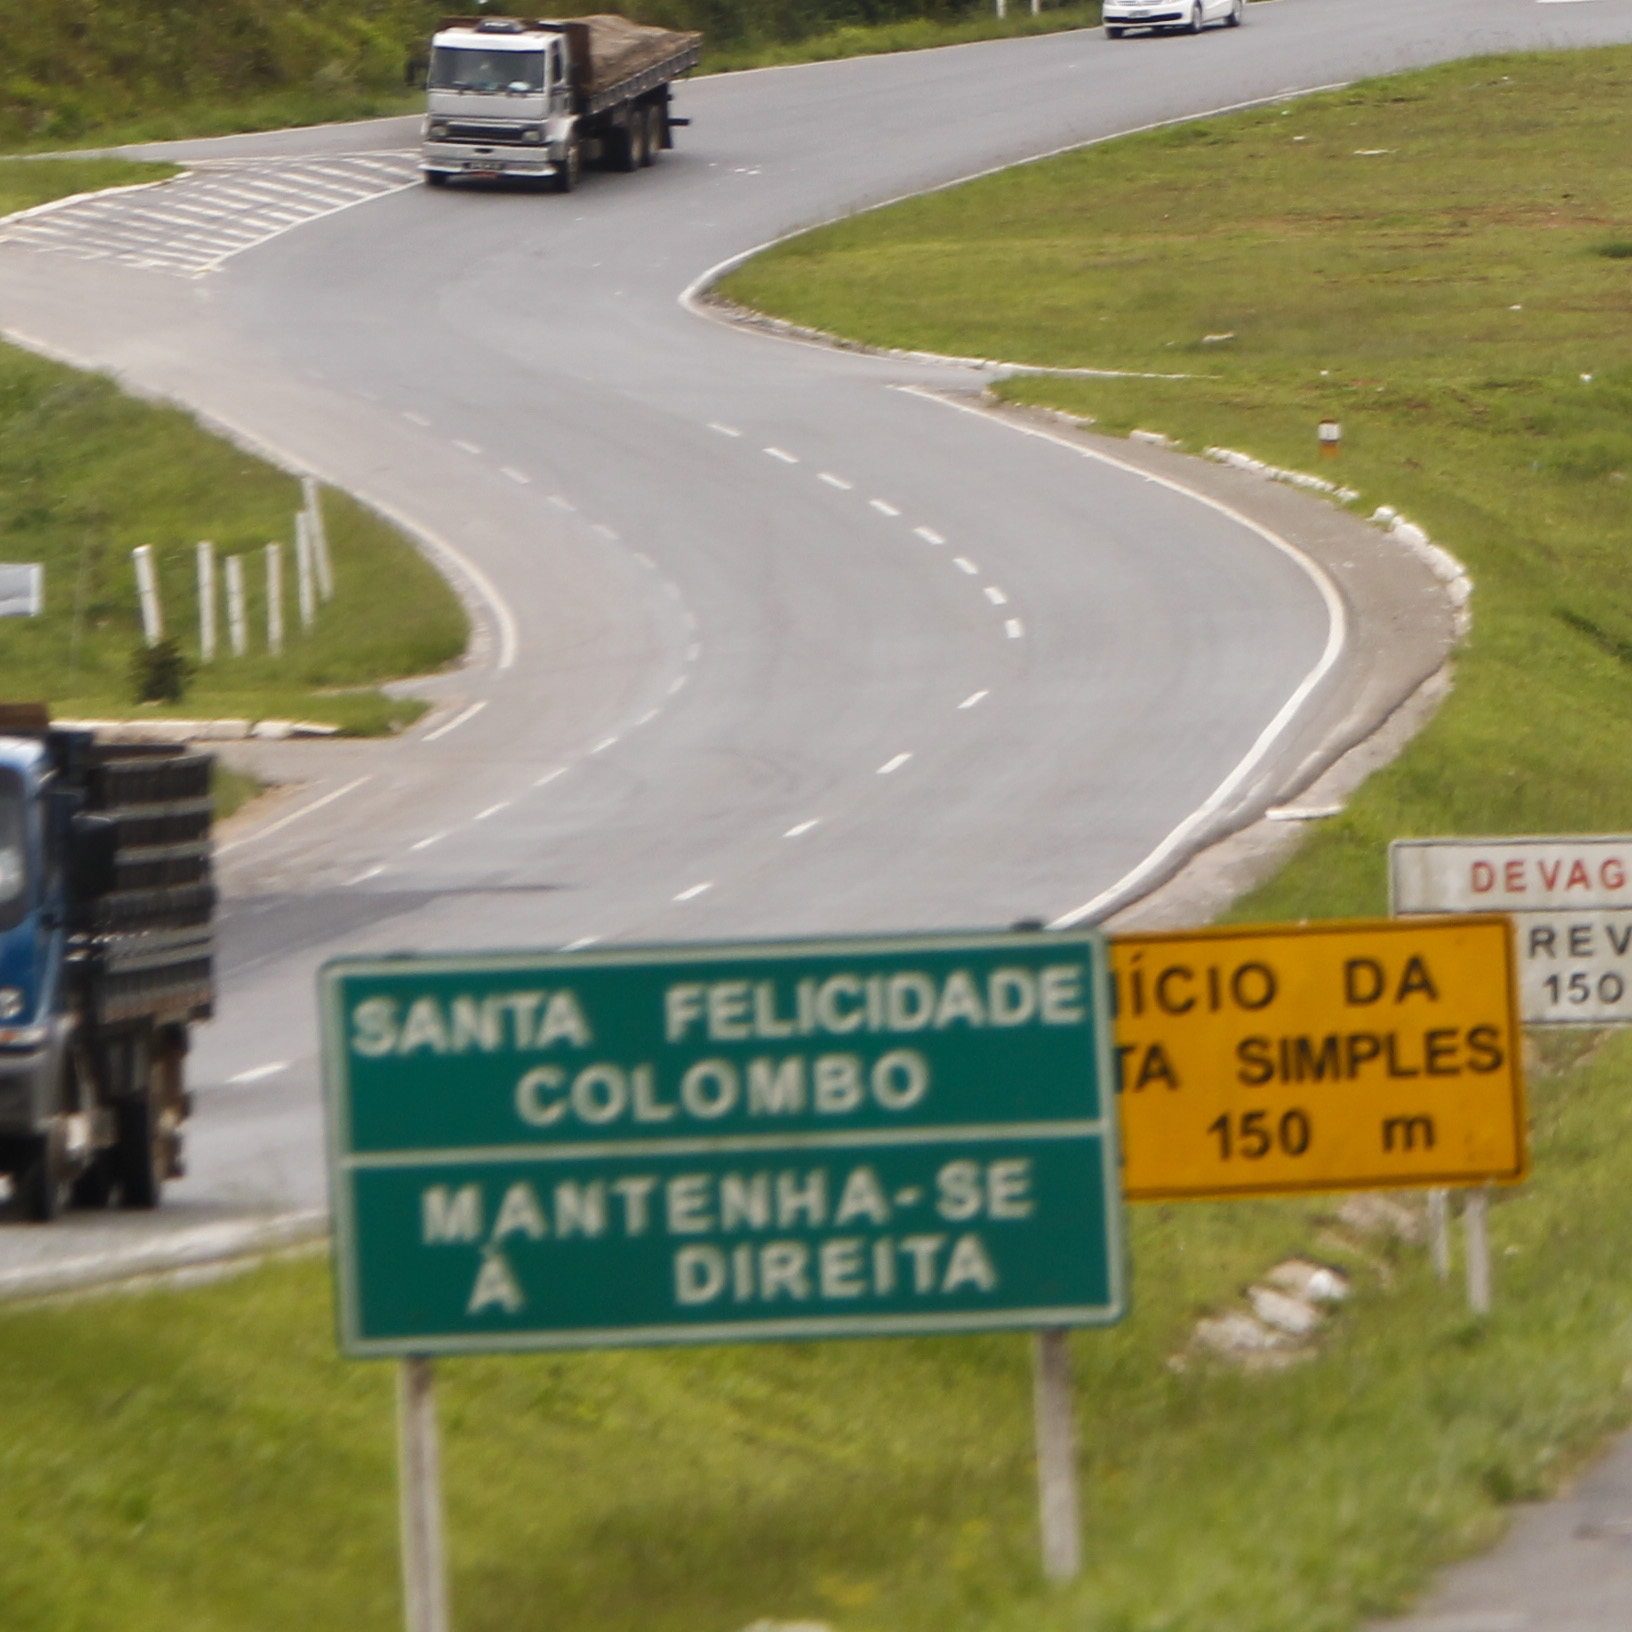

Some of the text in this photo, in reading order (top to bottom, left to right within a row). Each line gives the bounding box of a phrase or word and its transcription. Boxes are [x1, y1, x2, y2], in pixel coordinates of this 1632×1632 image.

[351, 964, 1086, 1057] SANTA FELICIDADE
[1107, 950, 1439, 1020] ÍCIO DA
[1543, 972, 1625, 1005] 150
[513, 1048, 932, 1127] COLOMBO
[1235, 1024, 1505, 1086] SIMPLES
[1206, 1108, 1436, 1161] 150 m
[421, 1158, 1036, 1246] MANTENHA-SE
[673, 1232, 998, 1306] DIREITA
